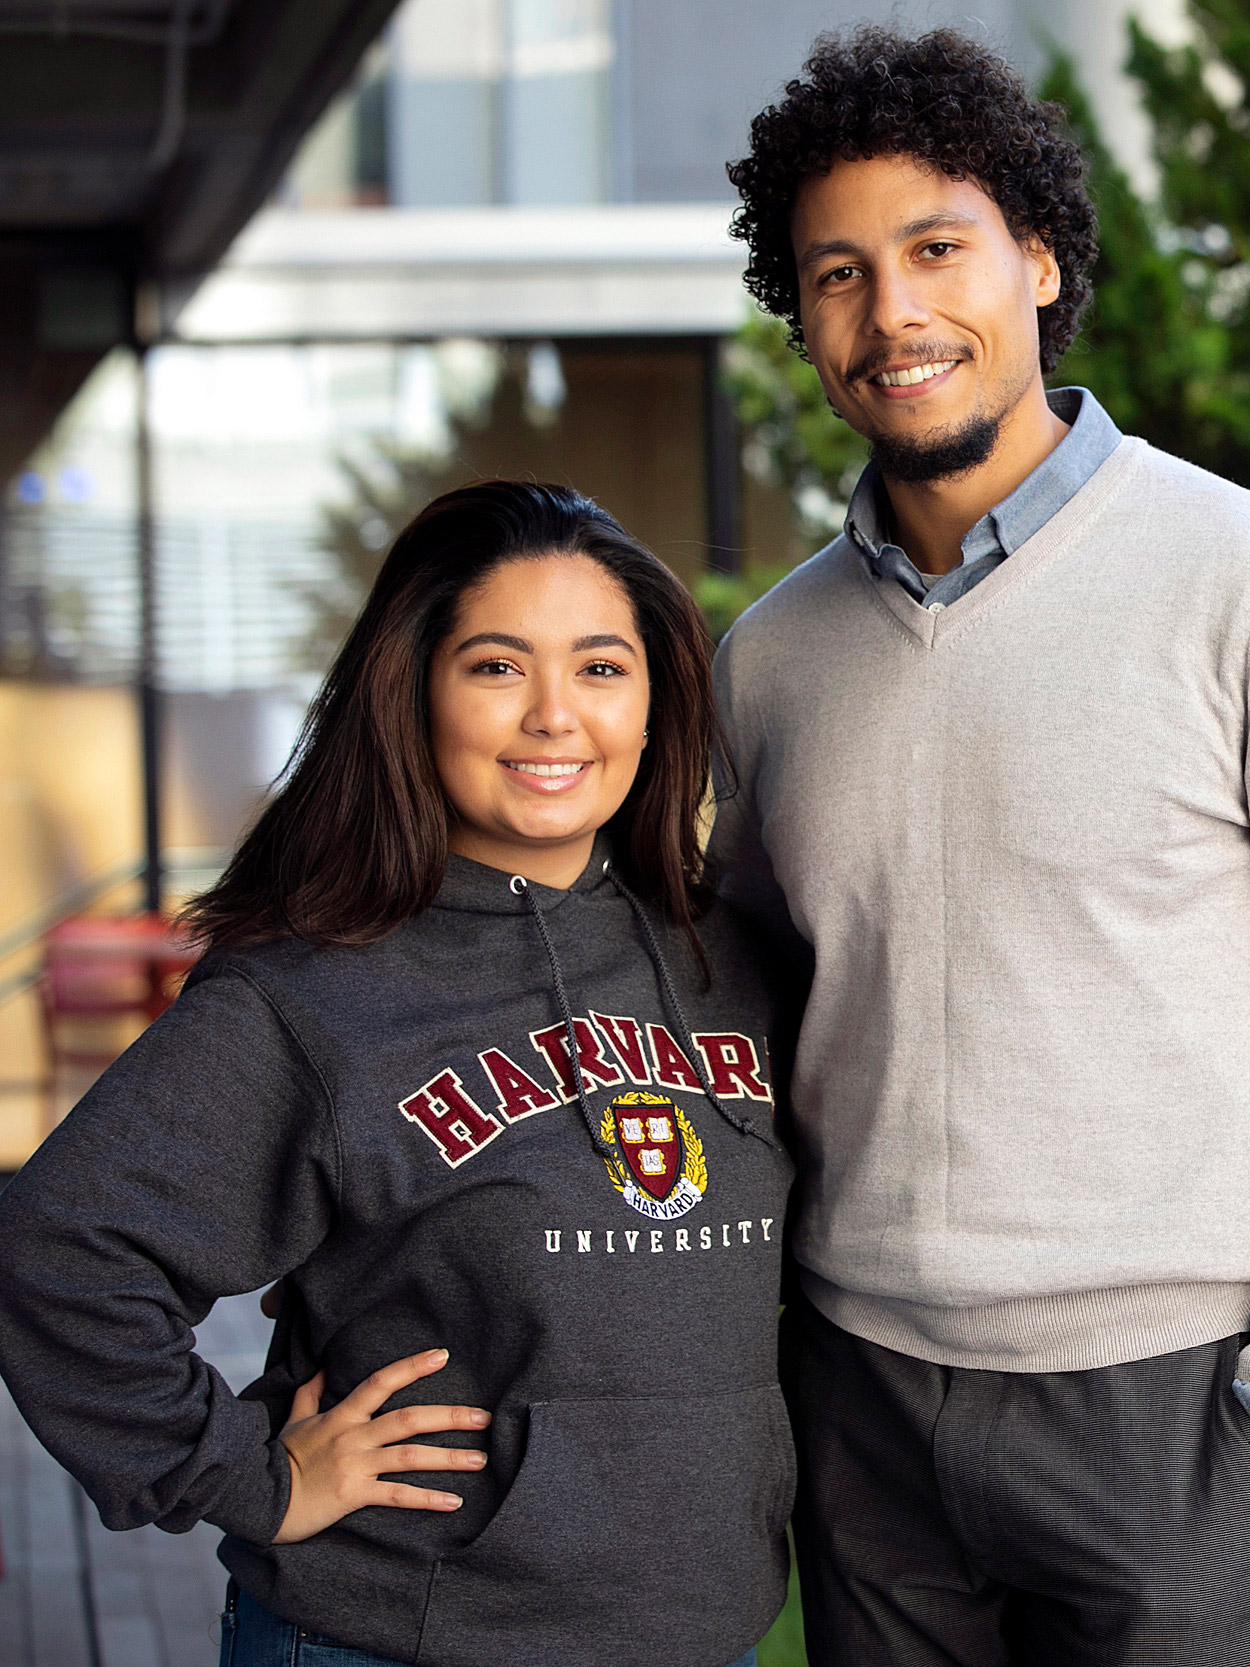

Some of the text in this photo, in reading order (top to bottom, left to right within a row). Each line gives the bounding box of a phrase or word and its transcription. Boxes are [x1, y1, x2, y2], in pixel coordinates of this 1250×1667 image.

[398, 1009, 776, 1170] HARVAR
[633, 1192, 693, 1218] HARVARD
[544, 1218, 774, 1254] UNIVERSITY
